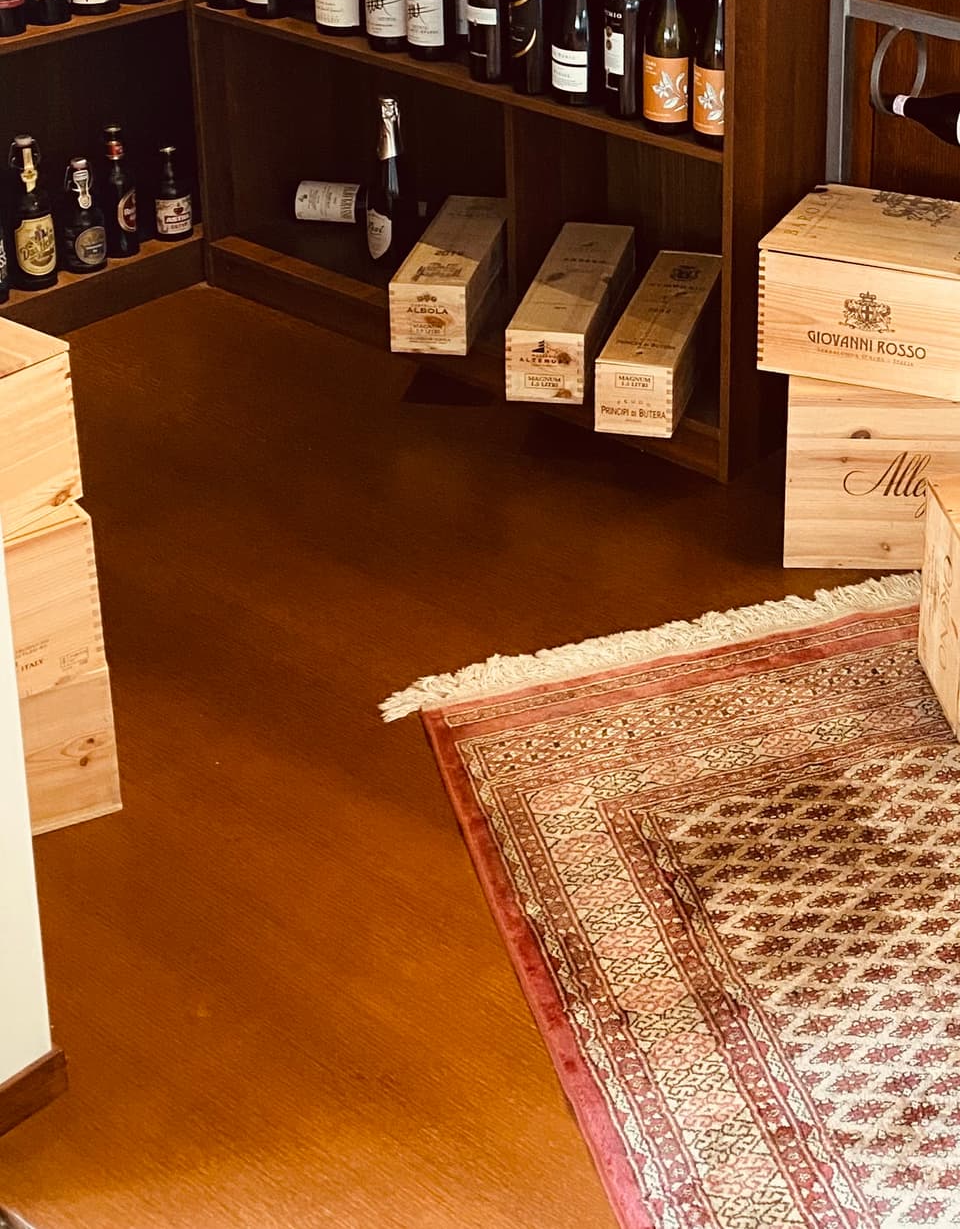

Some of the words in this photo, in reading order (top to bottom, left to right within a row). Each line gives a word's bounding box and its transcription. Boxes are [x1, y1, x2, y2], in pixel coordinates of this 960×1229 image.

[406, 307, 449, 315] ALBOLA
[808, 330, 872, 352] GIOVANNI
[877, 340, 927, 360] ROSSO
[528, 375, 561, 383] MAGNUM
[618, 375, 652, 383] MAGNUM
[601, 406, 629, 417] PRINCIPI
[638, 408, 666, 419] BUTERA
